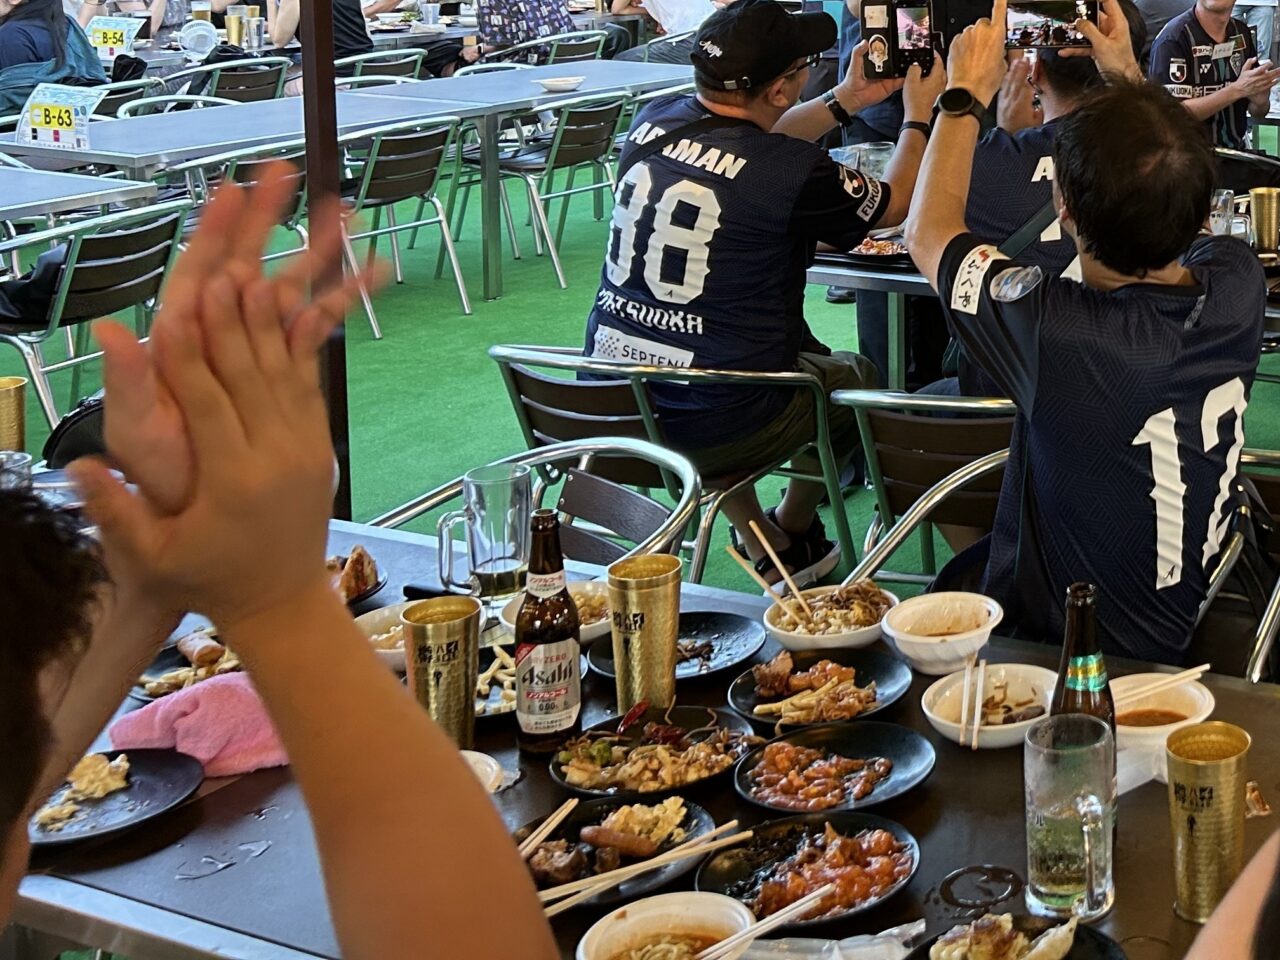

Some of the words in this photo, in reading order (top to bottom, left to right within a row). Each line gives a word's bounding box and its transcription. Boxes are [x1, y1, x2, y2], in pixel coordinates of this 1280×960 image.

[102, 31, 124, 45] B-54
[43, 107, 73, 127] B-63
[606, 160, 722, 305] 88
[958, 259, 981, 308] ふくや
[544, 653, 567, 664] ZERO
[521, 658, 573, 687] Asahi
